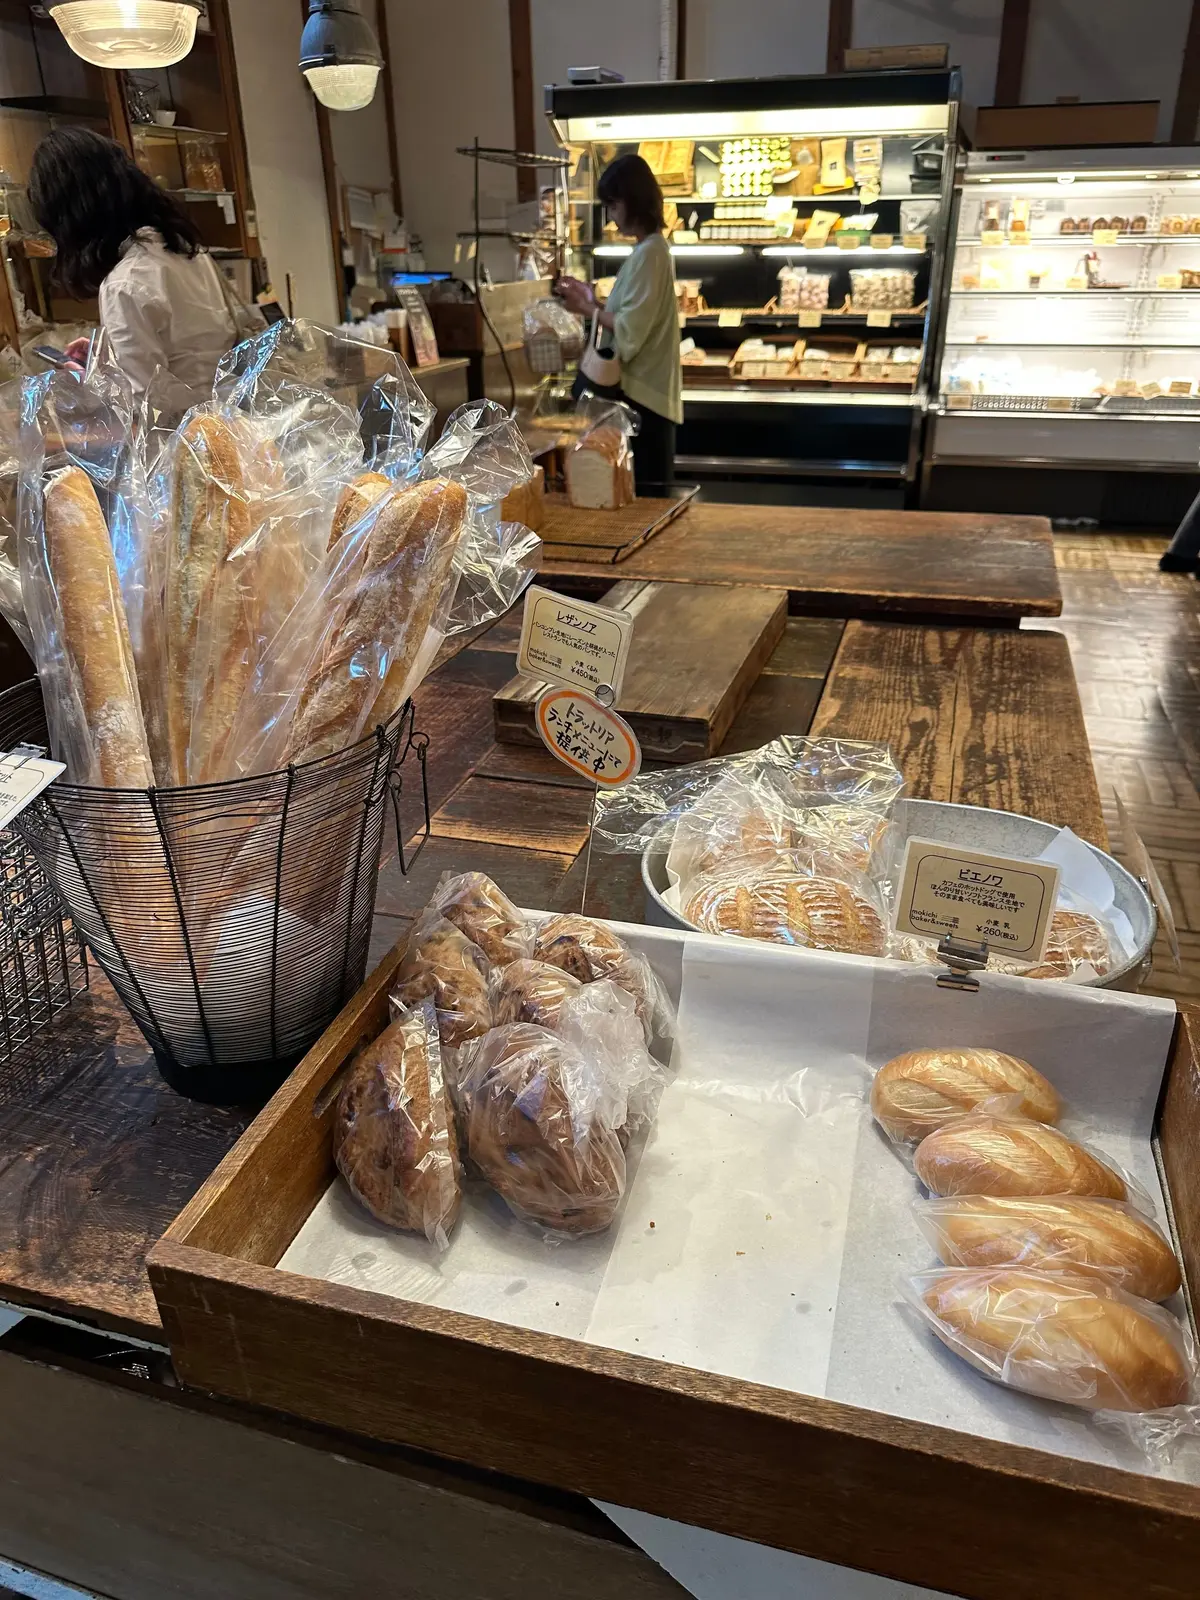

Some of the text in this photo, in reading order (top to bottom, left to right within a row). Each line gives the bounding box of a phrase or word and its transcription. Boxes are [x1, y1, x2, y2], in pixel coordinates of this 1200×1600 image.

[557, 611, 597, 633] レザンノア
[529, 647, 548, 658] mokichi
[543, 632, 602, 659] レストランでも人気のパンです。
[528, 652, 562, 669] baker&sweets
[574, 660, 599, 673] 小麦 くるみ
[566, 702, 615, 745] トラットリア
[547, 706, 622, 768] ランチメニューにて
[556, 730, 606, 774] 提供中
[930, 883, 1026, 908] ほんのり甘いソフトフランス生地で
[941, 879, 1016, 900] カフェのホットドッグで使用
[933, 891, 1020, 914] そのまま食べても美味しいです
[910, 915, 959, 930] baker&sweets
[911, 908, 938, 919] mokichi
[985, 918, 1011, 930] 小麦 乳
